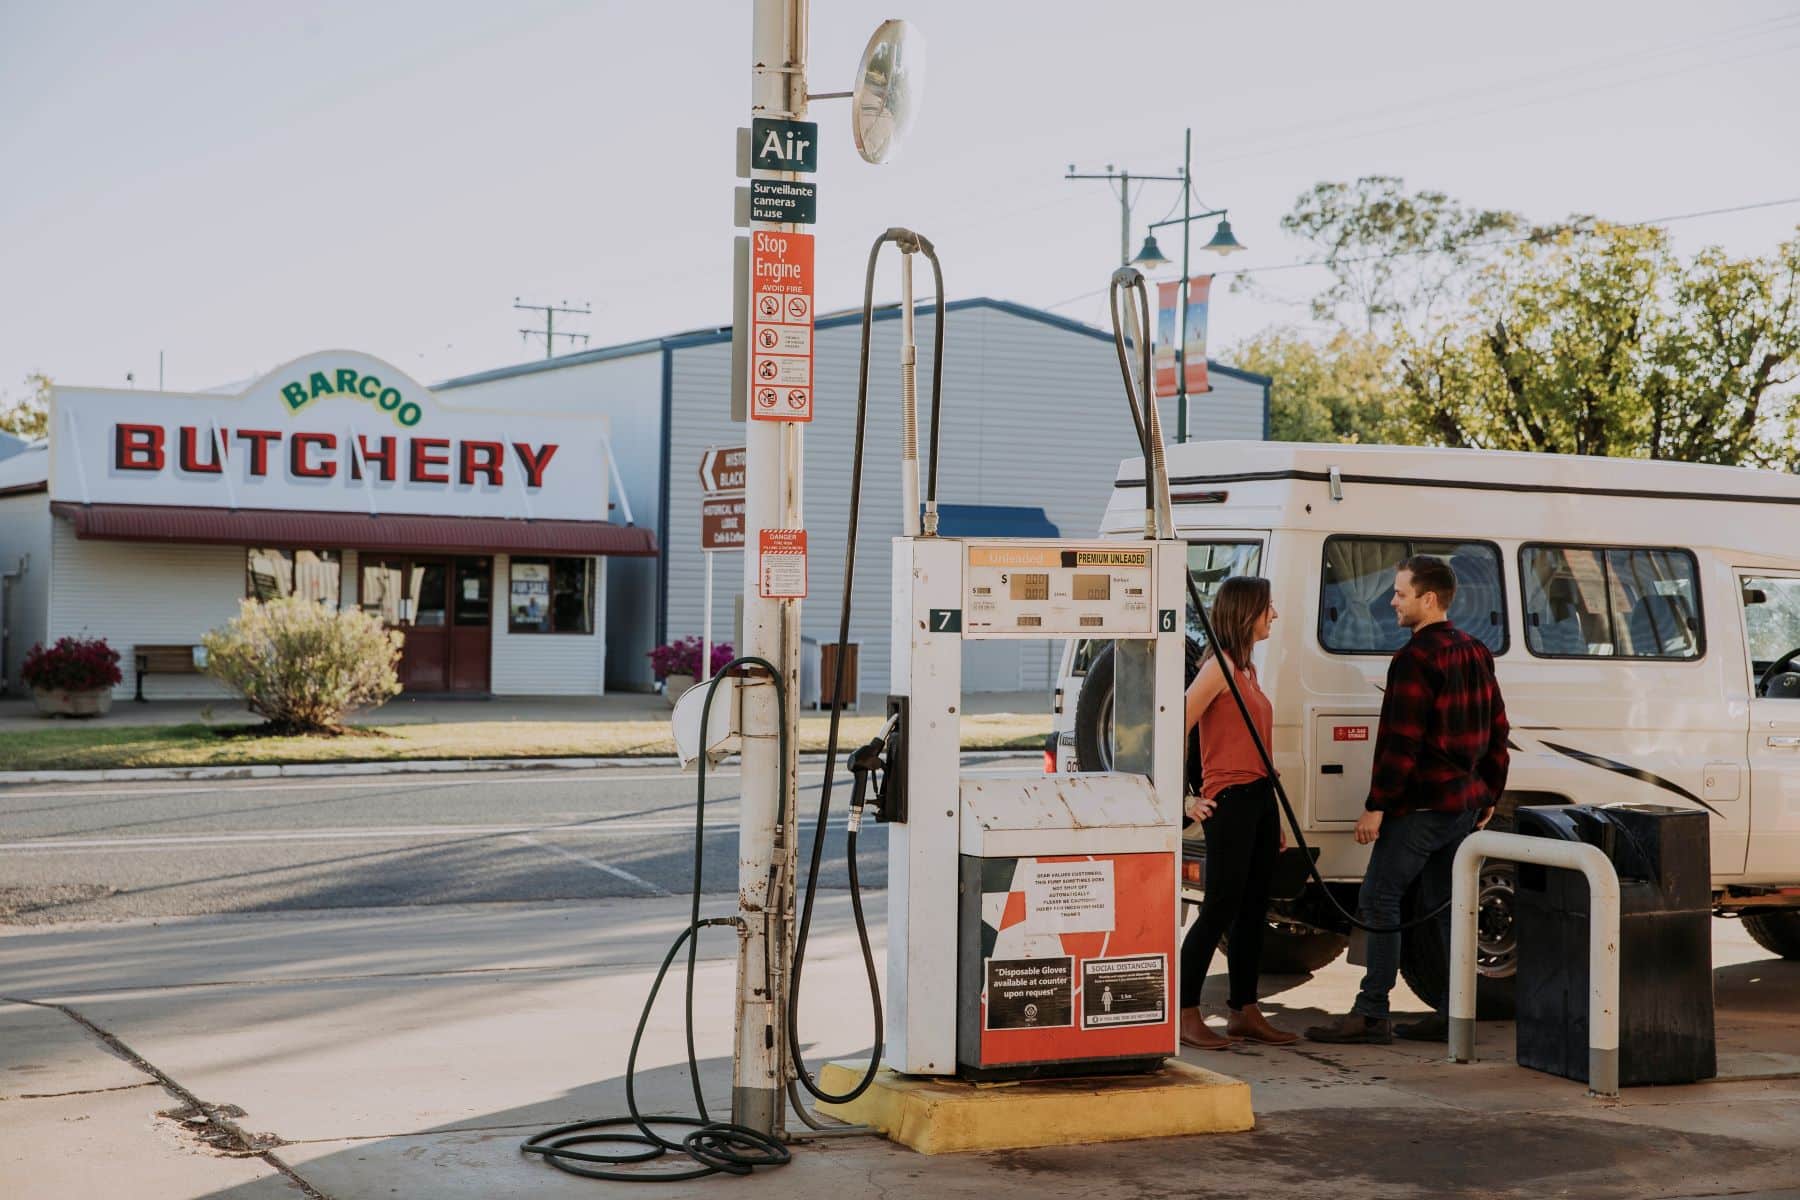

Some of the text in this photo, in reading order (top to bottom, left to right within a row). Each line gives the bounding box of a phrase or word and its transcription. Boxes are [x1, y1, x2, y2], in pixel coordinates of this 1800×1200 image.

[760, 131, 810, 160] Air
[754, 183, 813, 197] Surveillance
[754, 197, 796, 207] cameras
[753, 207, 783, 218] in use
[757, 233, 787, 259] Stop
[757, 257, 801, 283] Engine
[281, 368, 422, 427] BARCOO
[115, 423, 559, 488] BUTCHERY
[1079, 553, 1145, 564] PREMIUM UNLEADED
[938, 611, 952, 630] 7
[1162, 611, 1171, 630] 6
[1042, 966, 1067, 974] Gloves
[1116, 961, 1157, 969] DISTANCING
[994, 978, 1028, 987] available
[1038, 977, 1068, 985] counter
[1004, 990, 1024, 1000] upon
